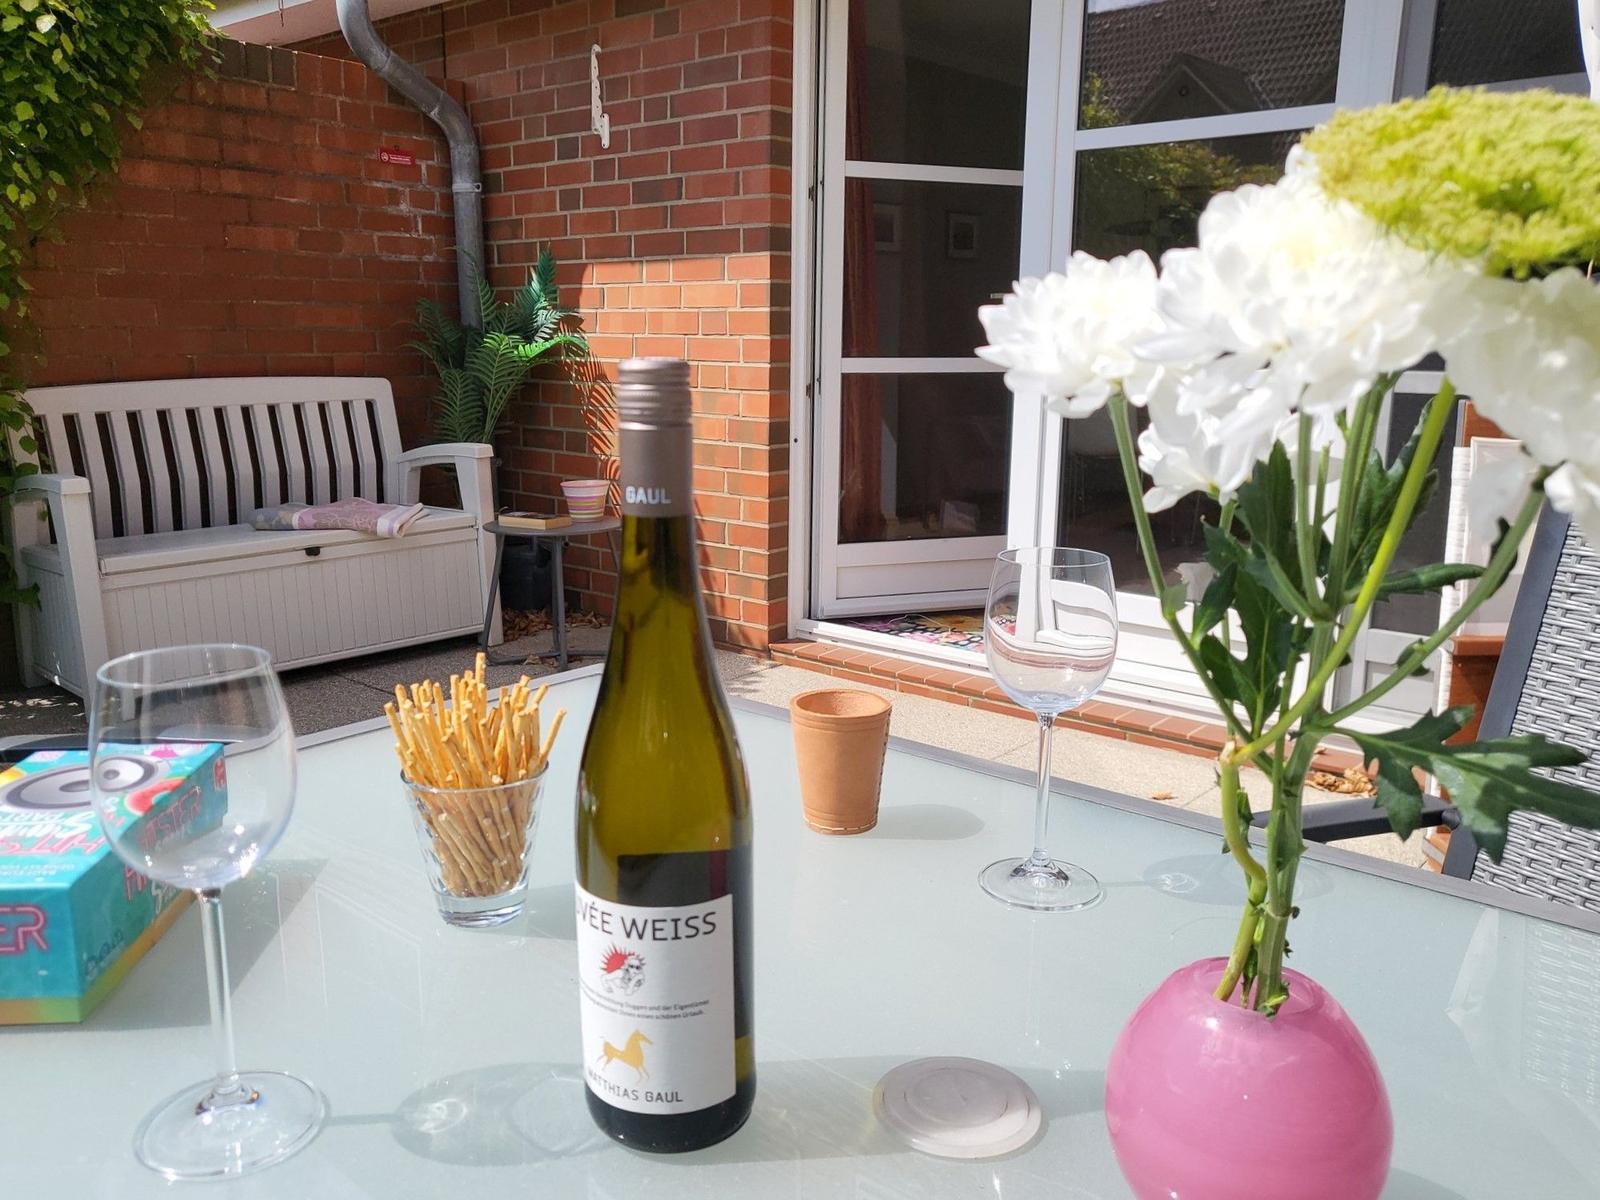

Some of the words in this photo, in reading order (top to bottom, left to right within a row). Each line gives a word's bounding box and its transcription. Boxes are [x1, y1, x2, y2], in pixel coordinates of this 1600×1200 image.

[625, 486, 672, 504] GAUL
[576, 900, 613, 935] VÉE
[621, 912, 717, 941] WEISS
[645, 1090, 684, 1103] GAUL
